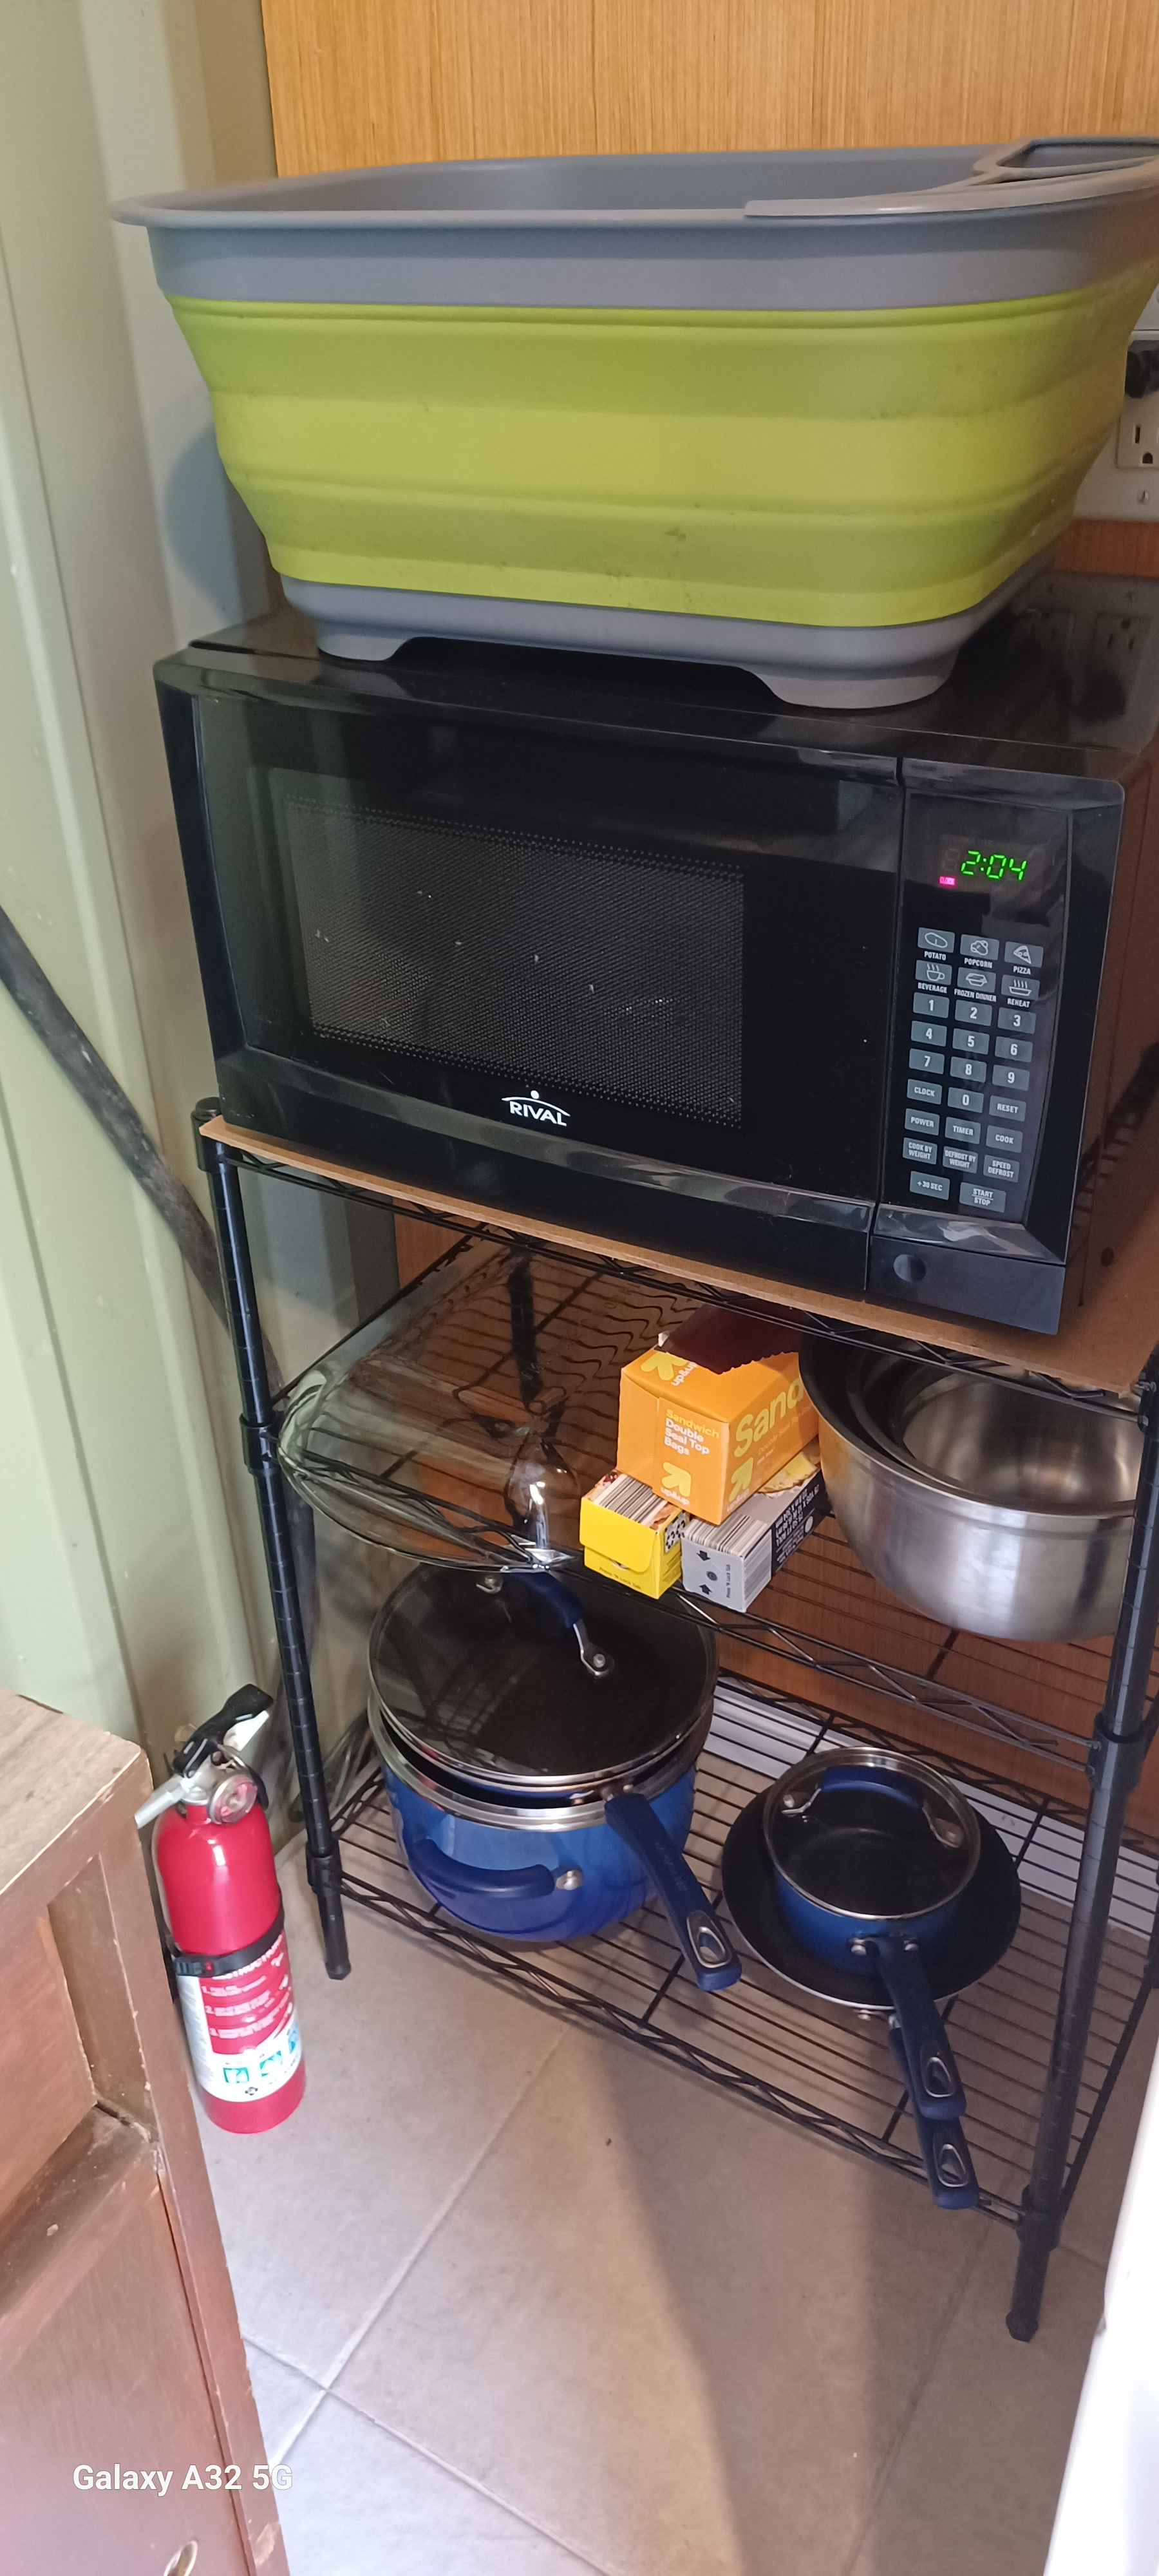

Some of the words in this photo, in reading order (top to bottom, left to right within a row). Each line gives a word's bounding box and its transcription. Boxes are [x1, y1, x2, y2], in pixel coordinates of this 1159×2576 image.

[961, 849, 1028, 881] 2:04
[924, 951, 947, 961] POTATO
[964, 957, 993, 969] POPCORN
[1013, 965, 1032, 976] PIZZA
[918, 982, 947, 994] BEVERAGE
[954, 988, 975, 999] FROZEN
[975, 992, 997, 1003] DINNER
[928, 999, 934, 1011] 1
[1007, 998, 1030, 1008] REHEAT
[970, 1007, 977, 1019] 2
[1013, 1014, 1021, 1027] 3
[925, 1028, 933, 1040] 4
[967, 1036, 975, 1048] 5
[1010, 1043, 1018, 1056] 6
[924, 1055, 931, 1067] 7
[965, 1063, 972, 1075] 8
[1007, 1072, 1015, 1084] 9
[914, 1086, 935, 1097] CLOCK
[962, 1094, 970, 1106] 0
[509, 1101, 567, 1126] RIVAL
[997, 1103, 1019, 1113] RESET
[910, 1116, 934, 1128] POWER
[952, 1125, 974, 1136] TIMER
[995, 1135, 1014, 1144] COOK
[908, 1142, 923, 1151] COOK
[909, 1149, 931, 1160] WEIGHT
[945, 1150, 968, 1161] DEFROST
[968, 1155, 977, 1163] BY
[949, 1158, 970, 1169] WEIGHT
[992, 1160, 1011, 1170] SPEED
[988, 1166, 1014, 1179] DEFROST
[930, 1182, 943, 1191] SEC
[973, 1188, 994, 1198] START
[974, 1197, 991, 1206] STOP
[666, 1408, 720, 1439] Sandwich
[665, 1417, 704, 1443] Double
[664, 1427, 688, 1445] Seal
[689, 1437, 710, 1455] Top
[664, 1437, 690, 1456] Bags
